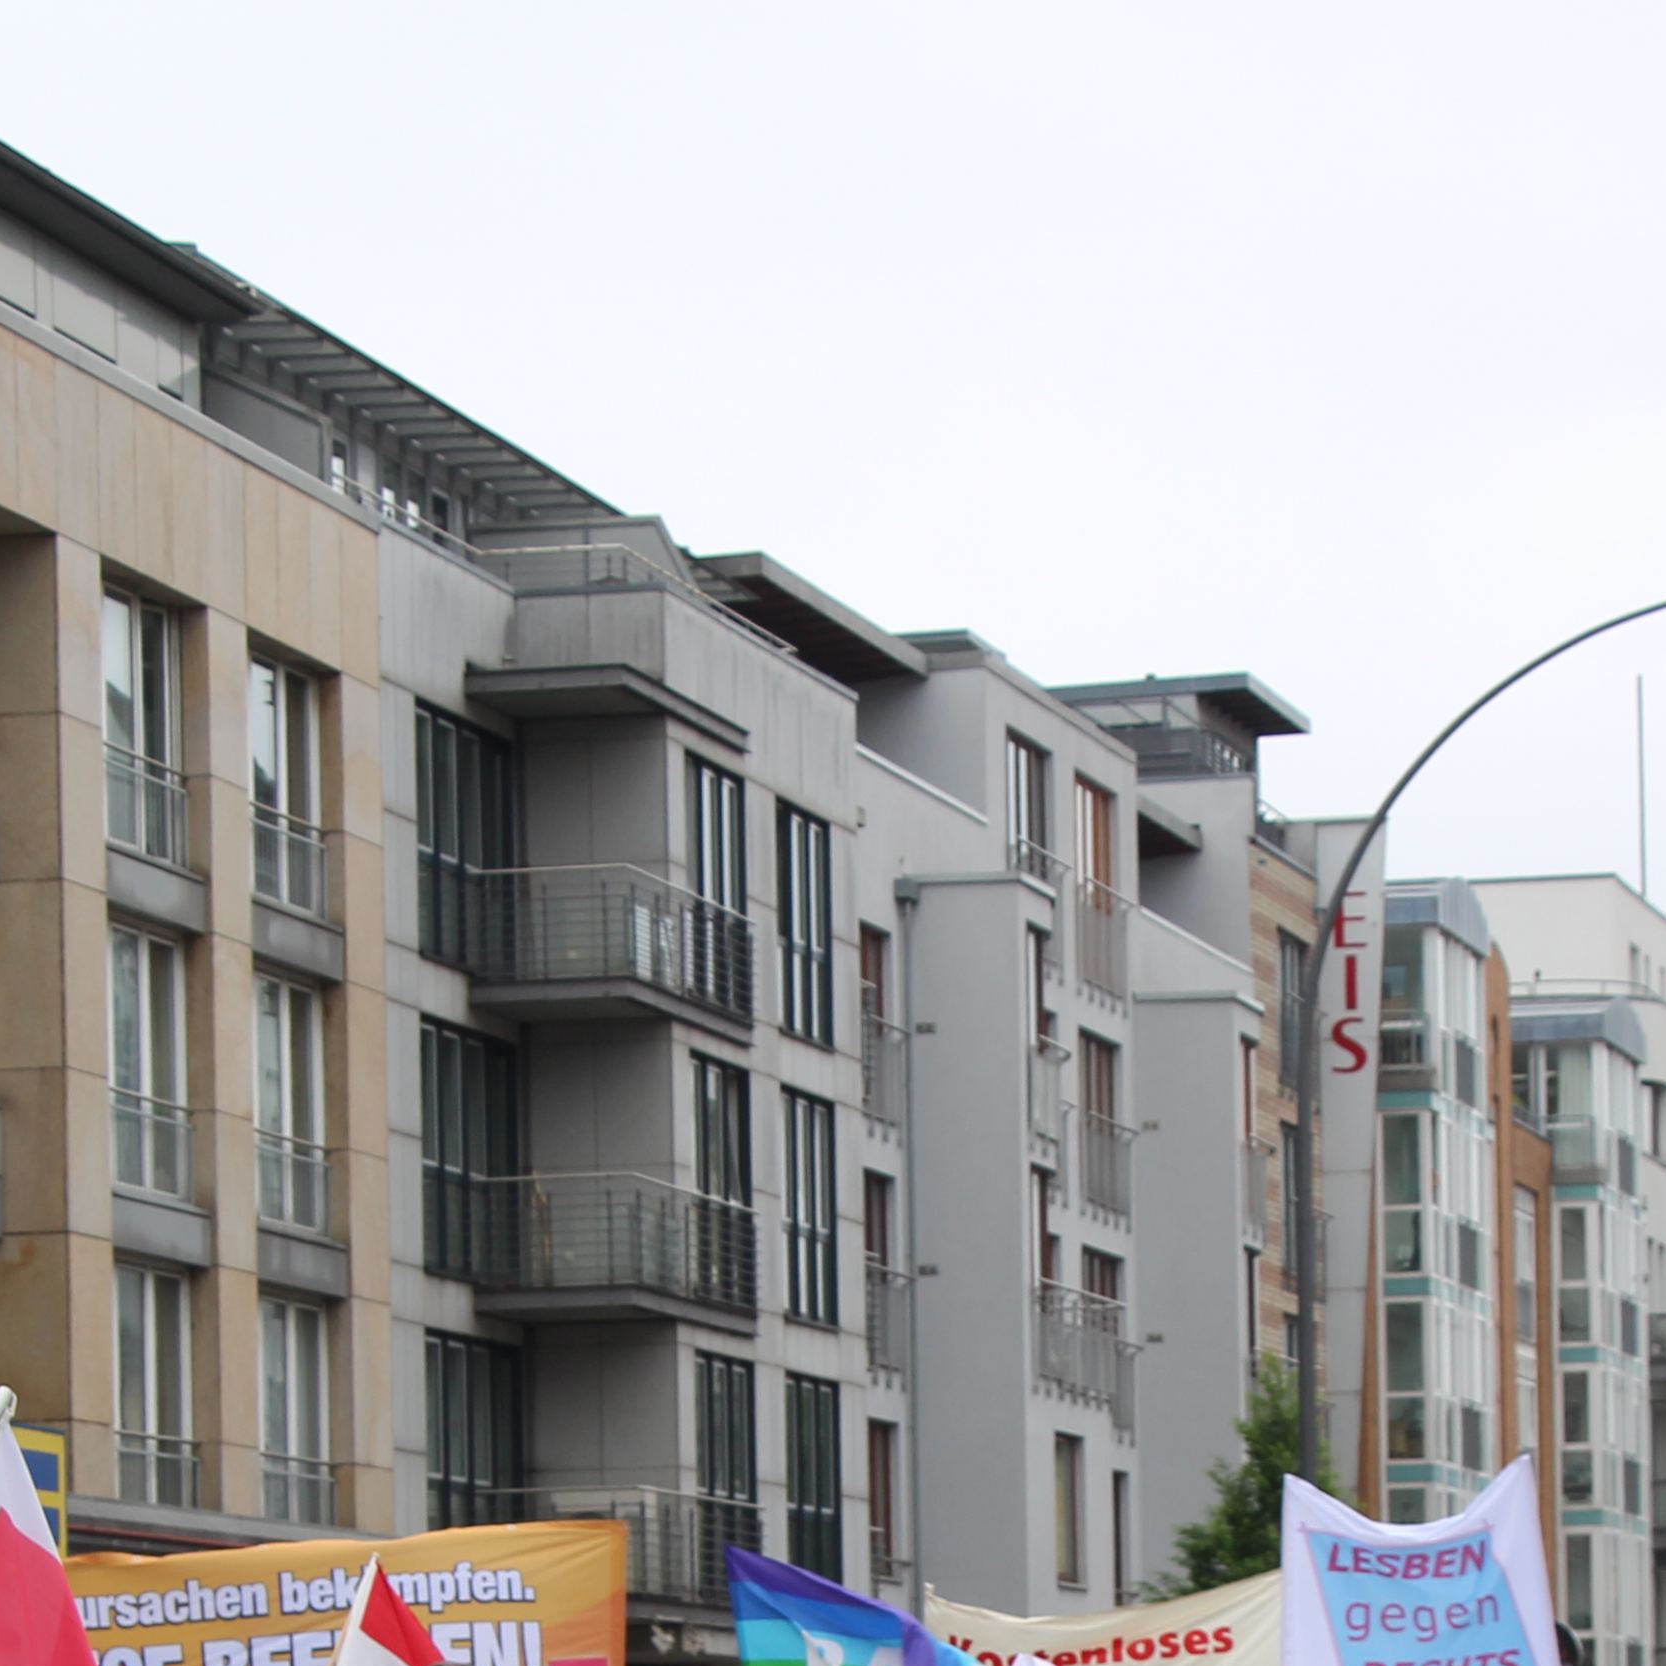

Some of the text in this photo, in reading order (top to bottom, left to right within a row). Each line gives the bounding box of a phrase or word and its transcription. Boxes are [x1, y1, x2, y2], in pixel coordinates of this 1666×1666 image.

[1328, 1540, 1486, 1580] LESBEN
[76, 1561, 537, 1630] ursachen bekmpfen.
[1344, 1593, 1500, 1643] gegen
